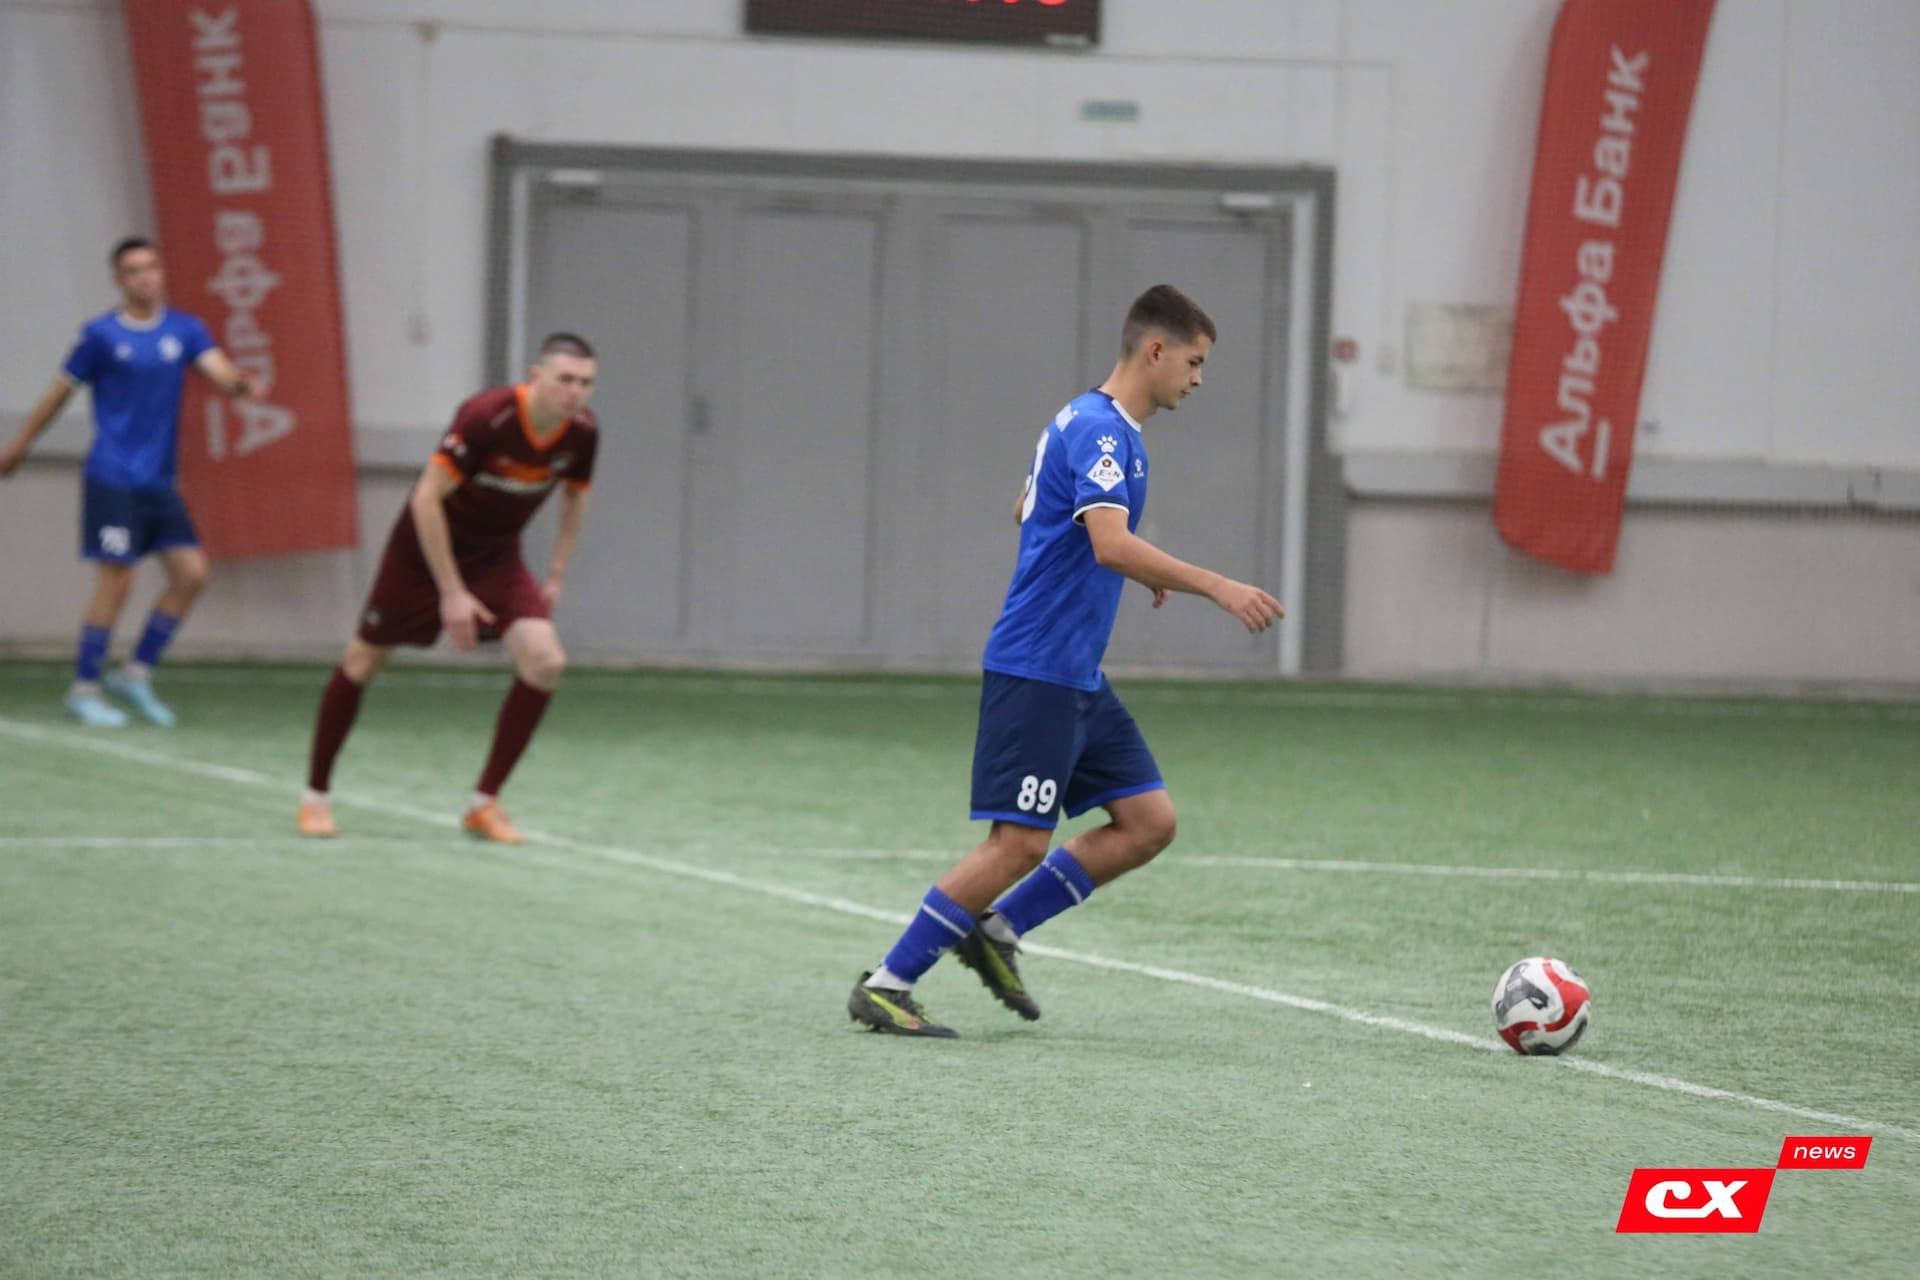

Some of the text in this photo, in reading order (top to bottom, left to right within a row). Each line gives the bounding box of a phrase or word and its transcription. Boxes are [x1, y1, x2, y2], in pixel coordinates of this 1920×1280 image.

[1539, 45, 1649, 478] Альфа Банк
[1017, 775, 1057, 814] 89
